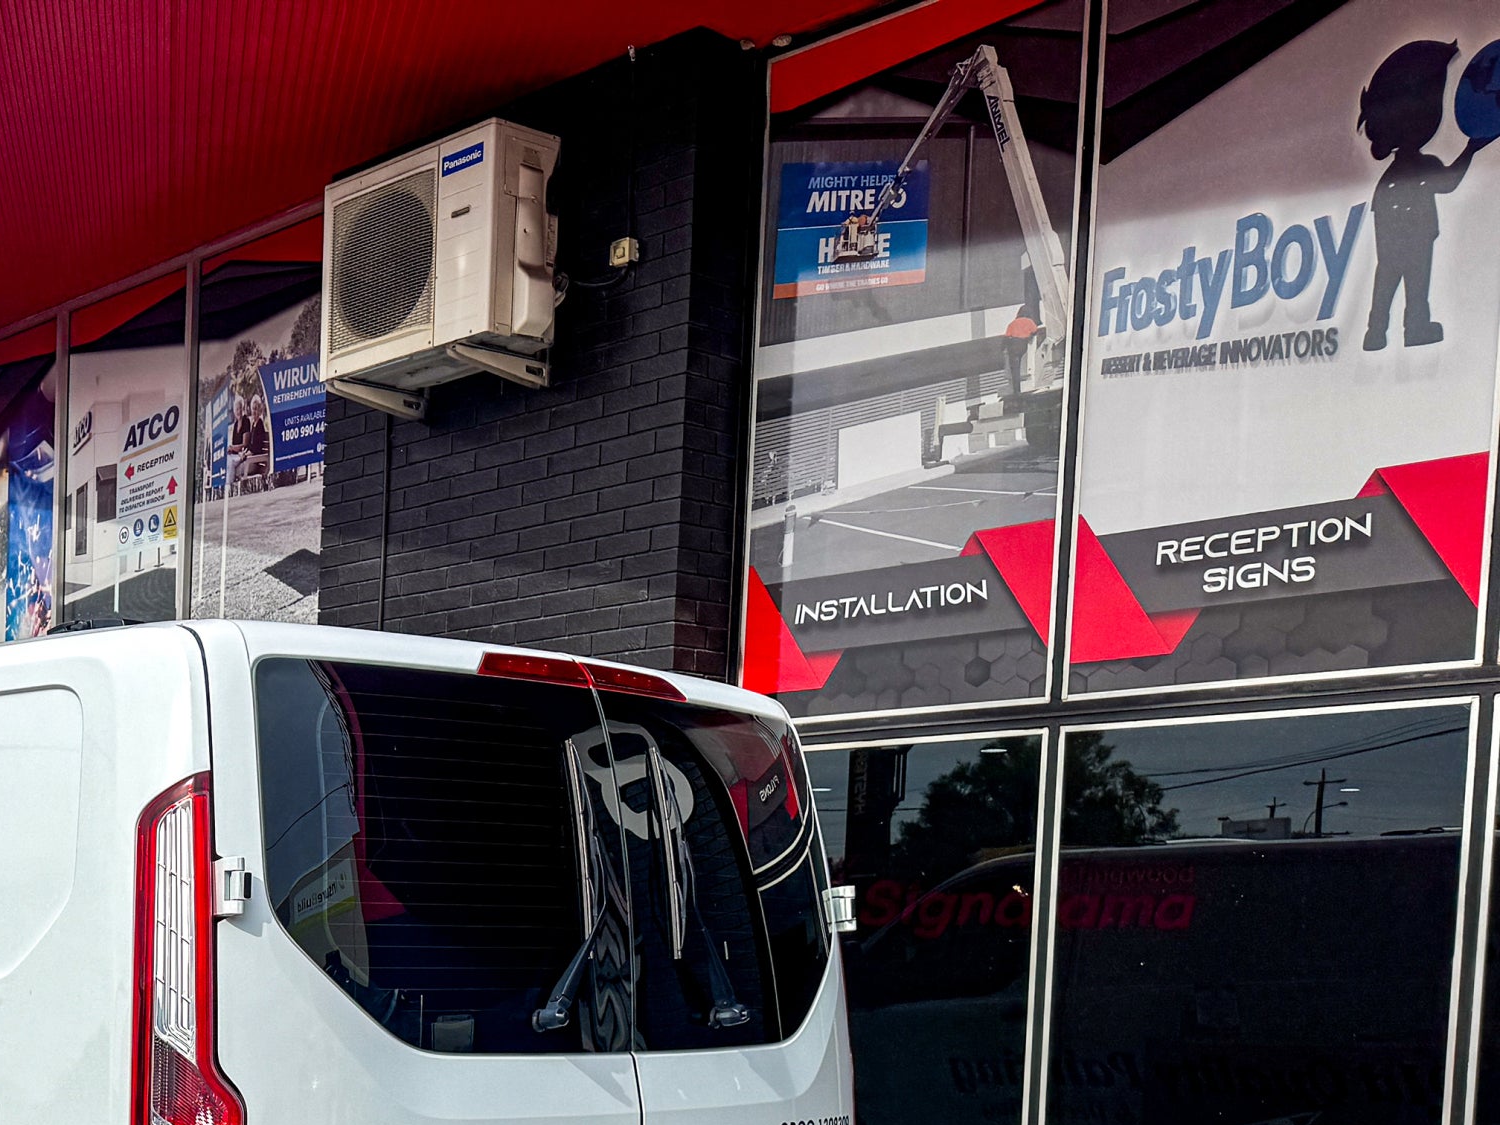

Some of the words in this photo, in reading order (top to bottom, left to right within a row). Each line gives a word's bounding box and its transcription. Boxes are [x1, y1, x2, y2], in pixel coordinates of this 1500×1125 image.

[443, 148, 482, 171] Panasonic
[808, 175, 858, 189] MIGHTY
[806, 189, 876, 213] MITRE
[818, 233, 891, 264] HE
[1152, 343, 1218, 371] BEVERAGE
[1219, 327, 1339, 365] INNOVATORS
[273, 386, 311, 403] RETIREMENT
[123, 405, 180, 452] ATCO
[281, 428, 299, 441] 1800
[136, 451, 175, 473] RECEPTION
[1155, 512, 1372, 565] RECEPTION
[1202, 556, 1316, 593] SIGNS
[794, 579, 988, 625] INSTALLATION
[860, 879, 1195, 937] Signaama
